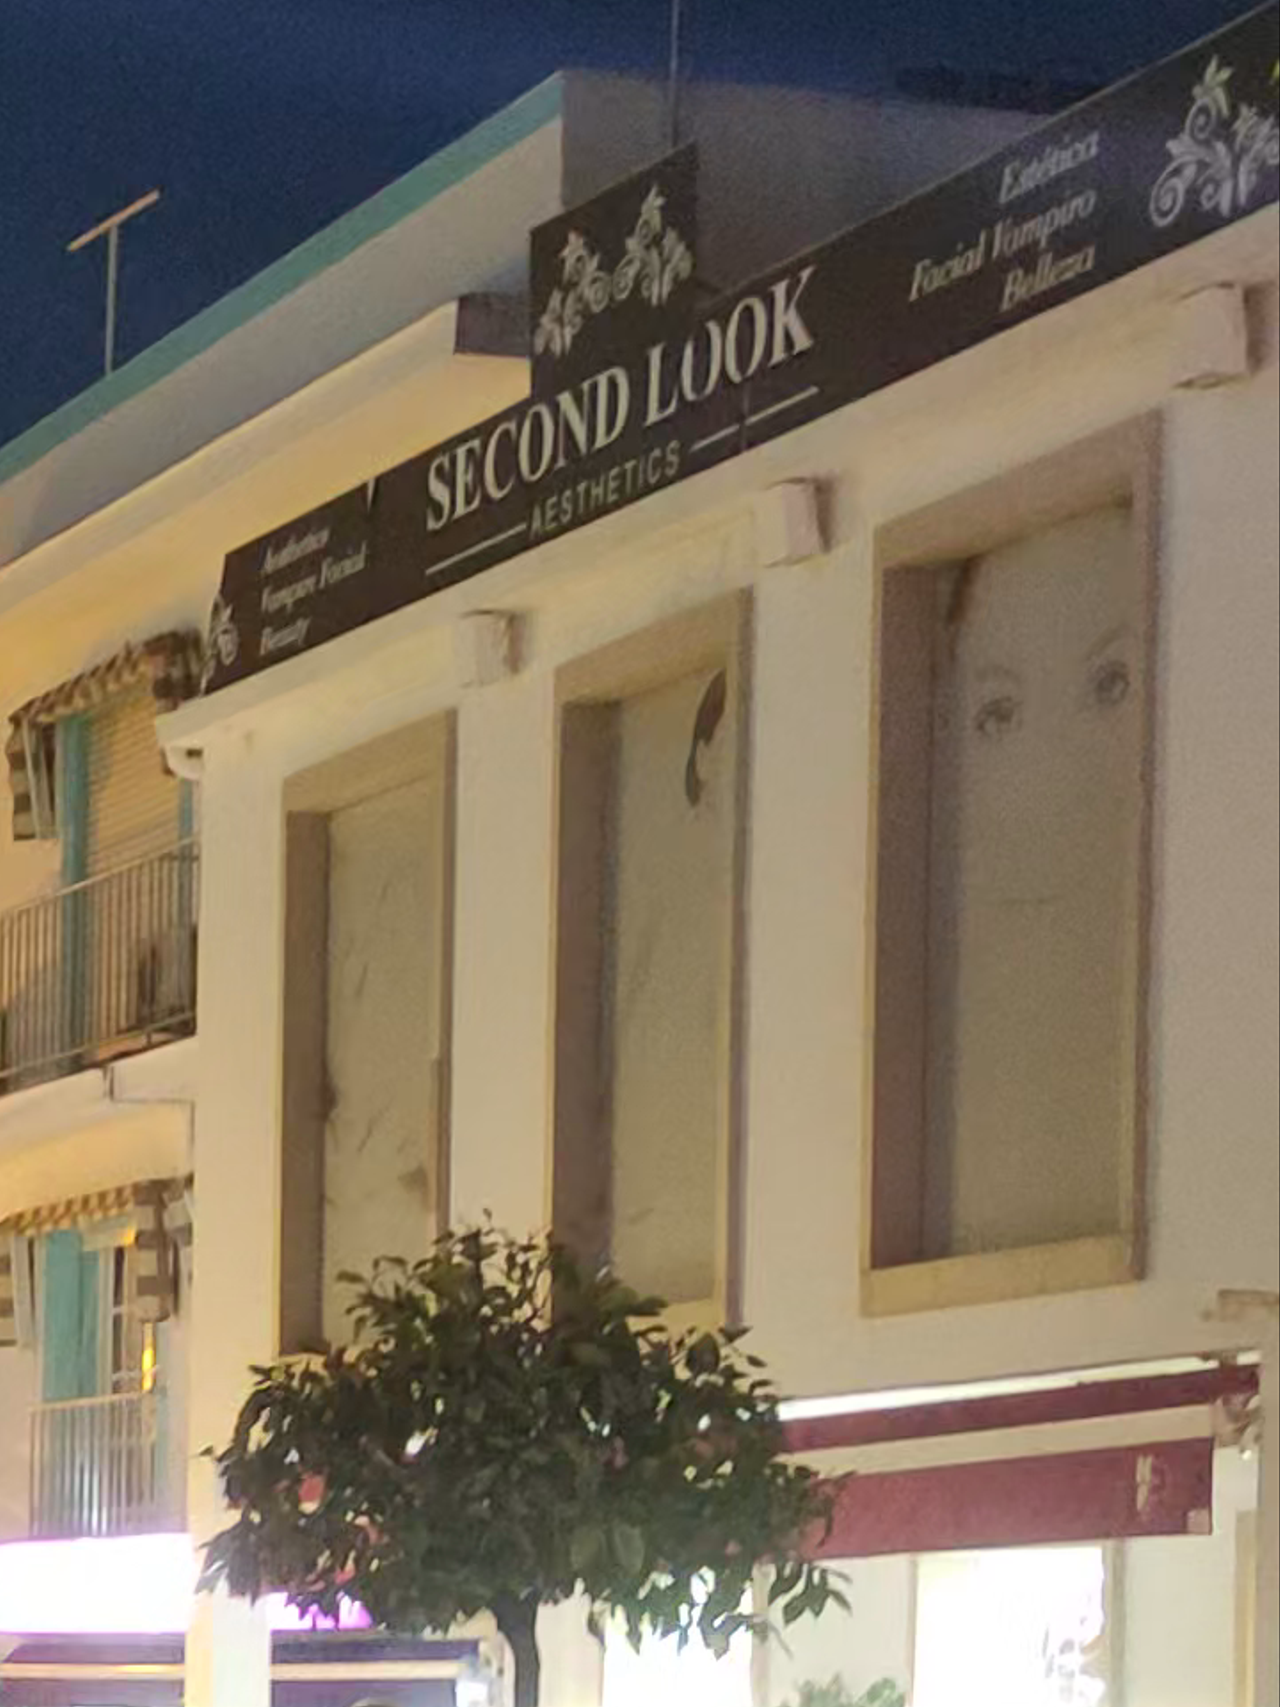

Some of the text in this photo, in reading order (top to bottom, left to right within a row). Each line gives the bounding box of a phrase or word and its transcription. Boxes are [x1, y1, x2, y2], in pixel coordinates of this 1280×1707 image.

[909, 190, 1097, 303] Facial Vampiro
[999, 244, 1096, 314] Belleza
[426, 264, 817, 532] SECOND LOOK
[528, 439, 682, 542] AESTHETICS
